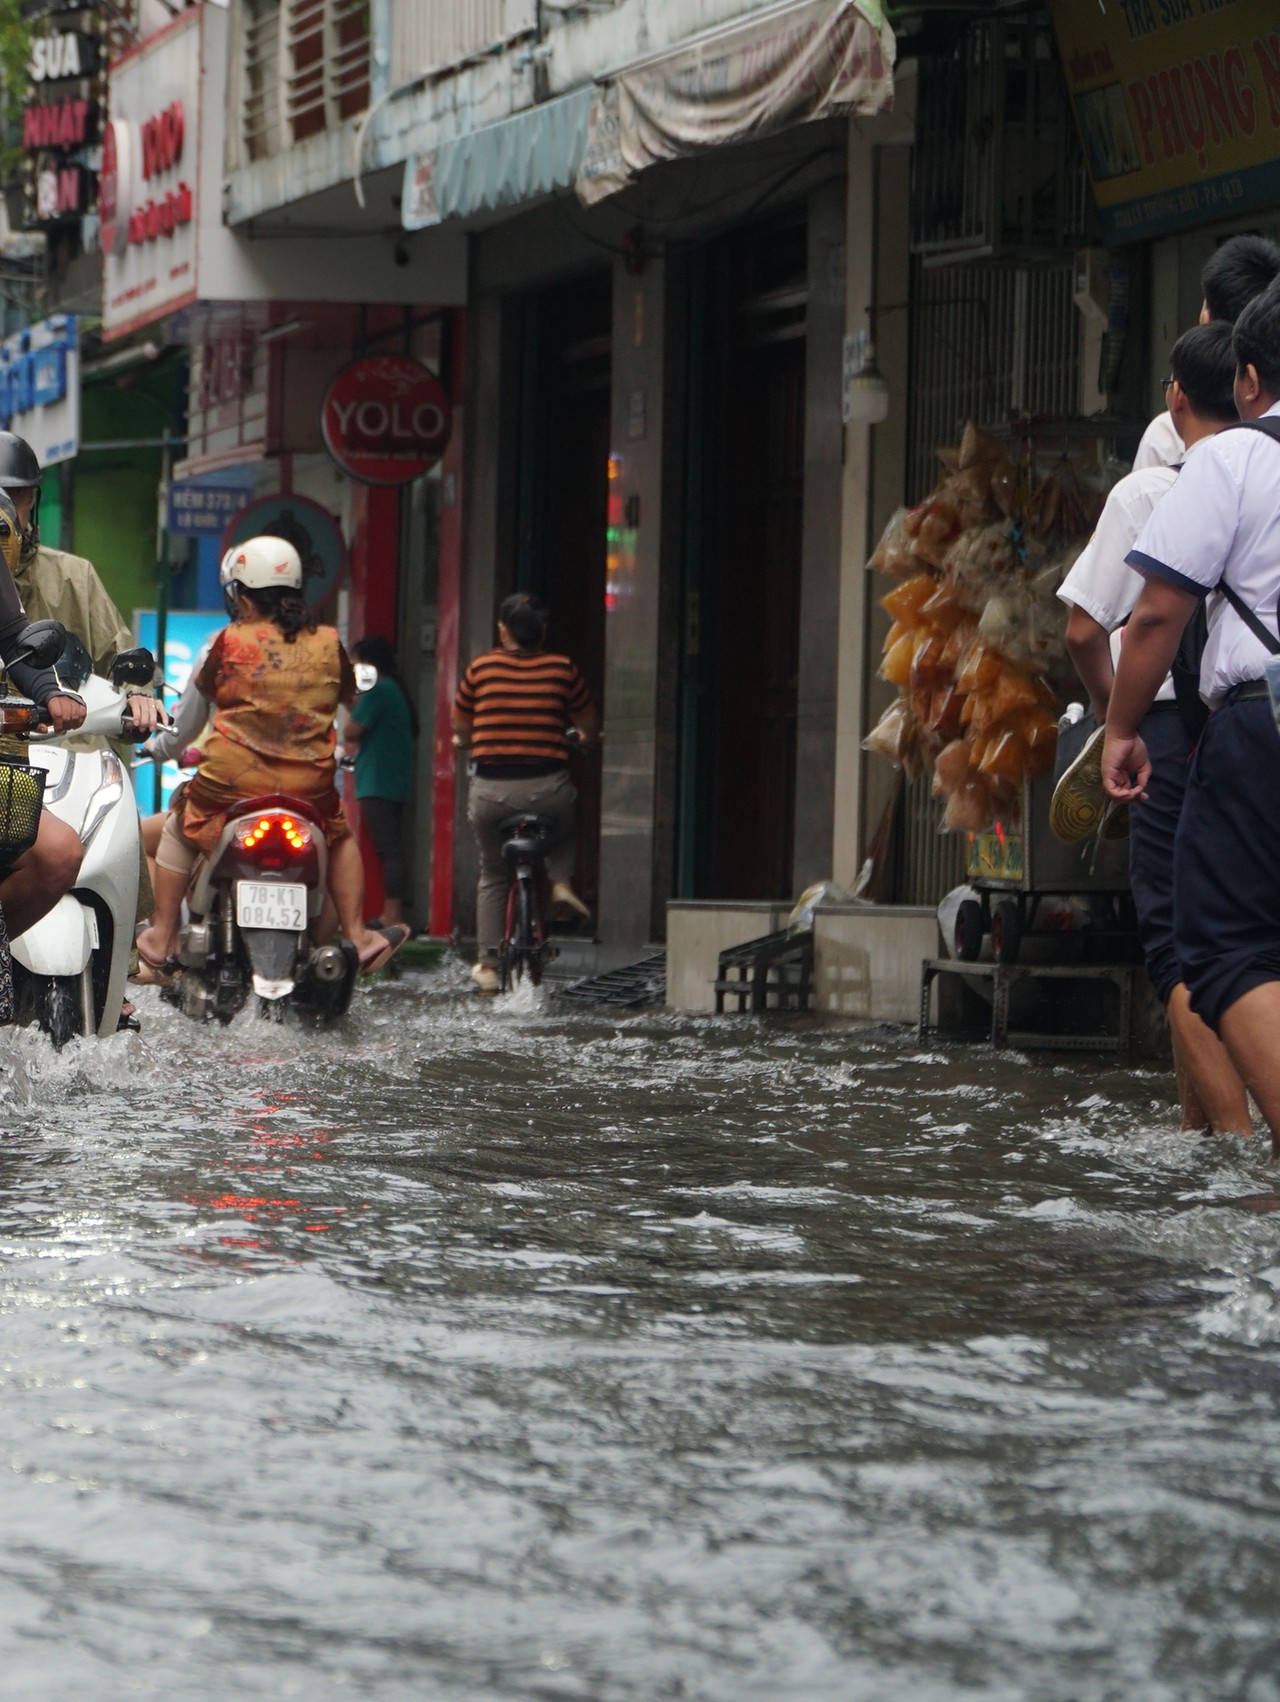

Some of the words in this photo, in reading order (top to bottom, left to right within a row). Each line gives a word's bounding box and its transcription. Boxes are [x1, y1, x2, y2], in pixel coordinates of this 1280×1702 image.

[1127, 47, 1256, 171] PHỤNG
[331, 400, 445, 439] YOLO
[250, 886, 295, 906] 78-K1
[243, 906, 302, 927] 084.52
